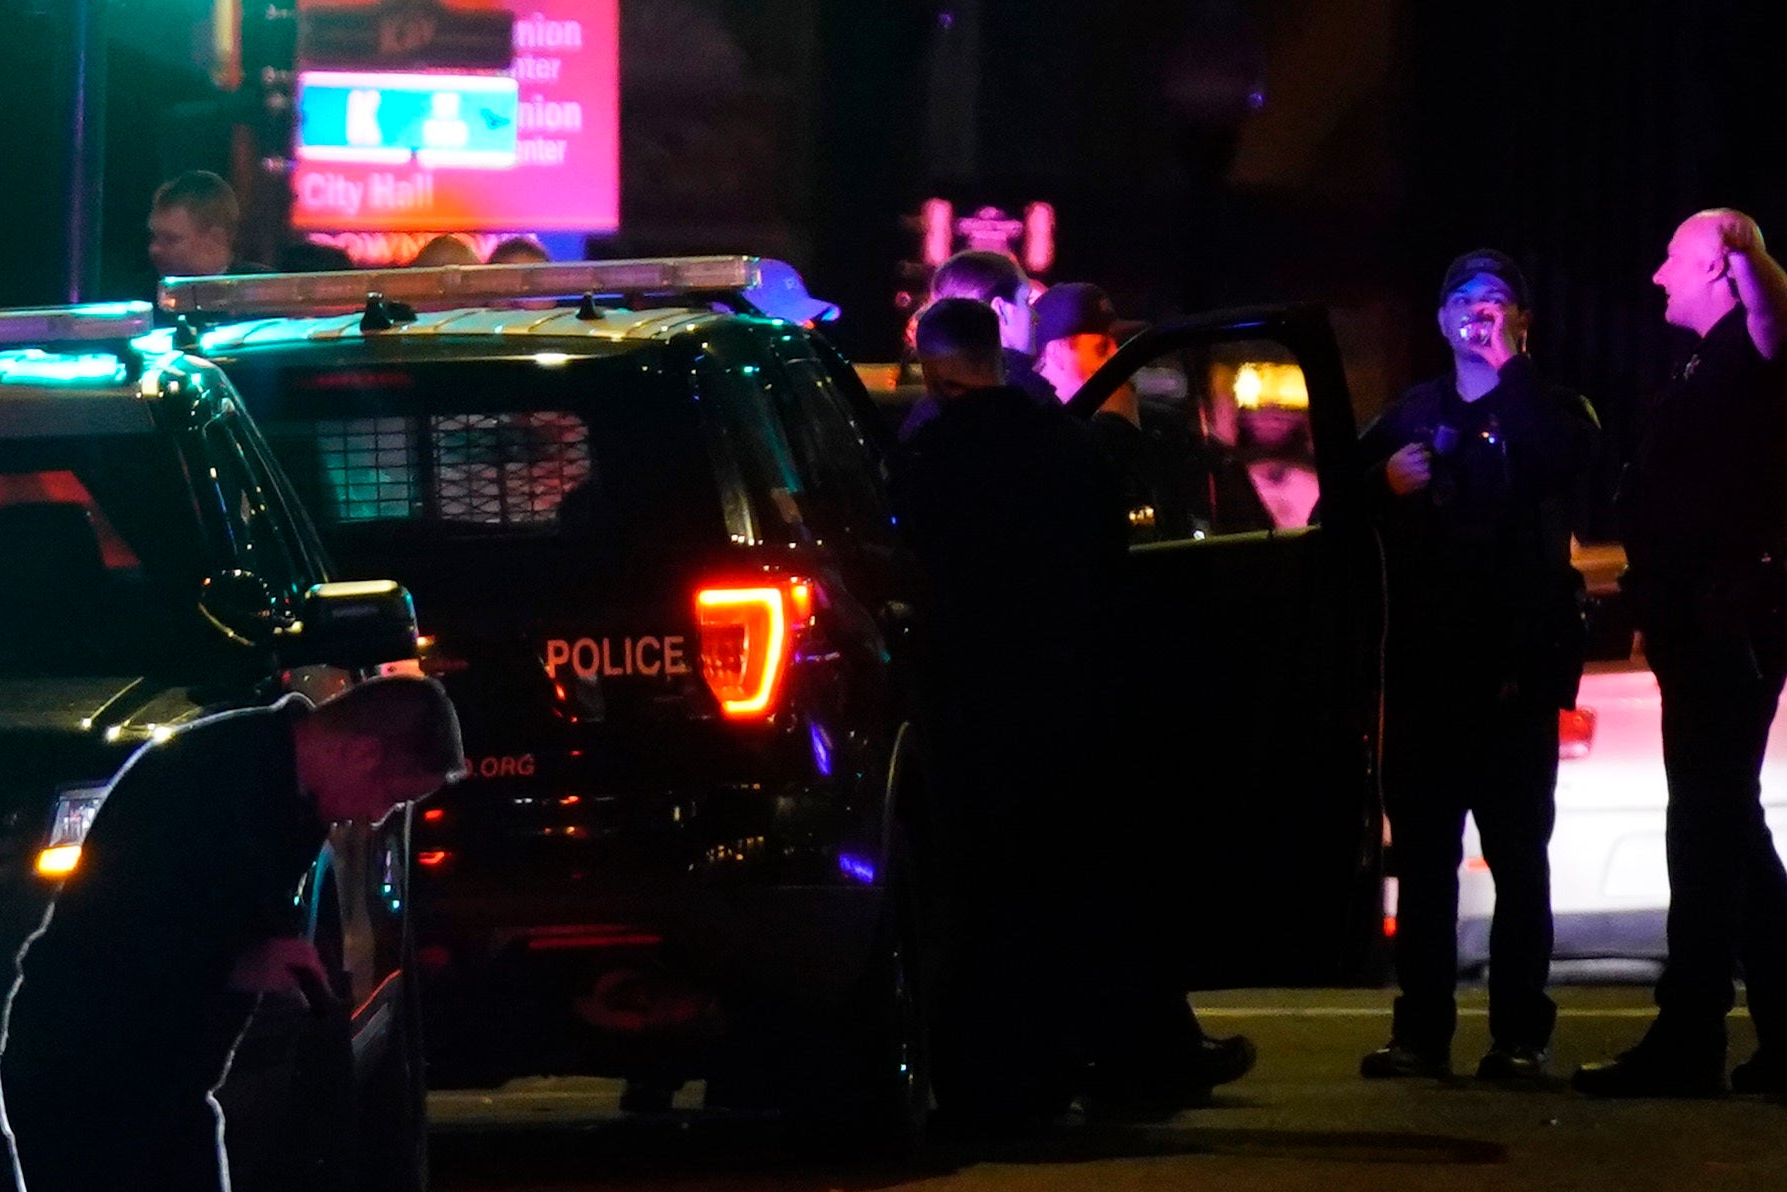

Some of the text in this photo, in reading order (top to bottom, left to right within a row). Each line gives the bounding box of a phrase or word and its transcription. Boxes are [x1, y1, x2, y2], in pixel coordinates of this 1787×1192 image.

[302, 173, 434, 216] City Hall
[547, 636, 685, 678] POLICE
